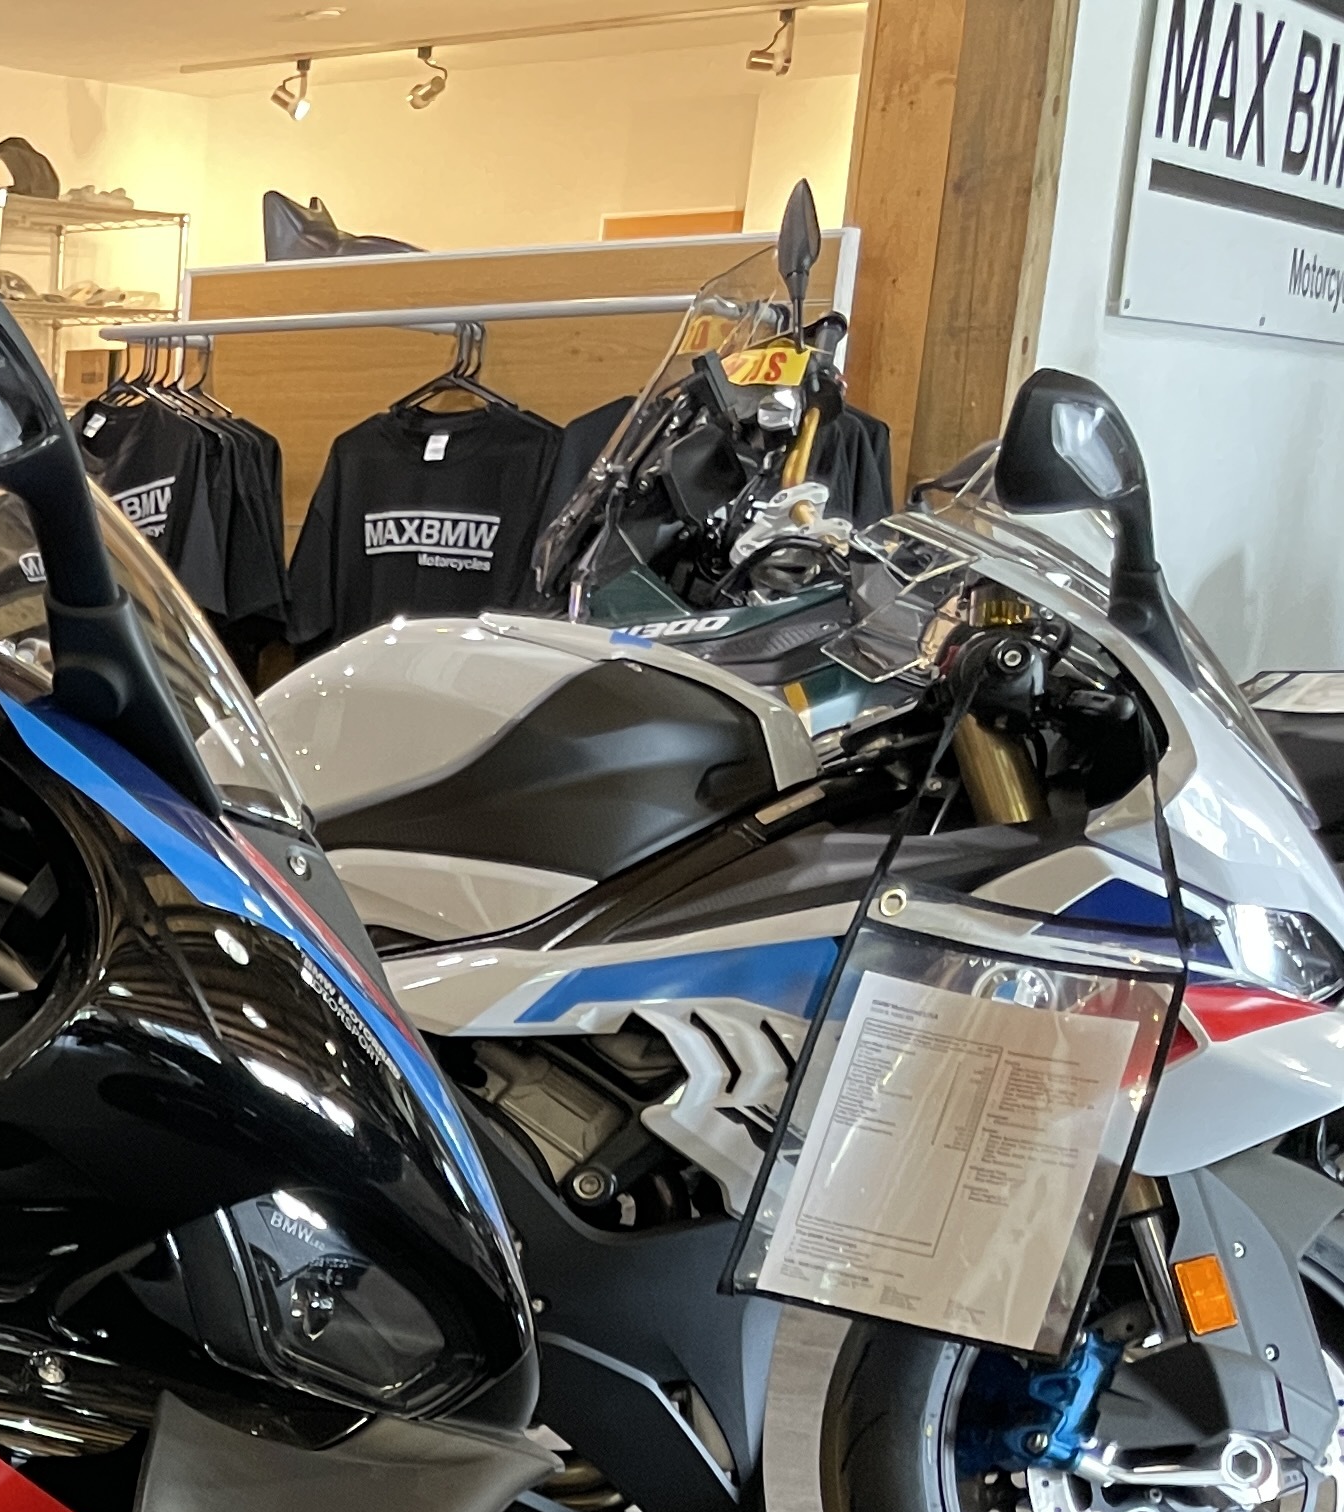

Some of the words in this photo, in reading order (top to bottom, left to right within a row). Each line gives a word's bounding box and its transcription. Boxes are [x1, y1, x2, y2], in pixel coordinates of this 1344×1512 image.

[1155, 0, 1286, 167] MAX
[1282, 29, 1344, 189] BM
[1288, 247, 1344, 314] Motorcy
[365, 519, 499, 549] MAXBMW
[418, 552, 491, 571] Motorcycles
[301, 966, 381, 1066] OTORSPORT
[270, 1210, 313, 1243] BMW
